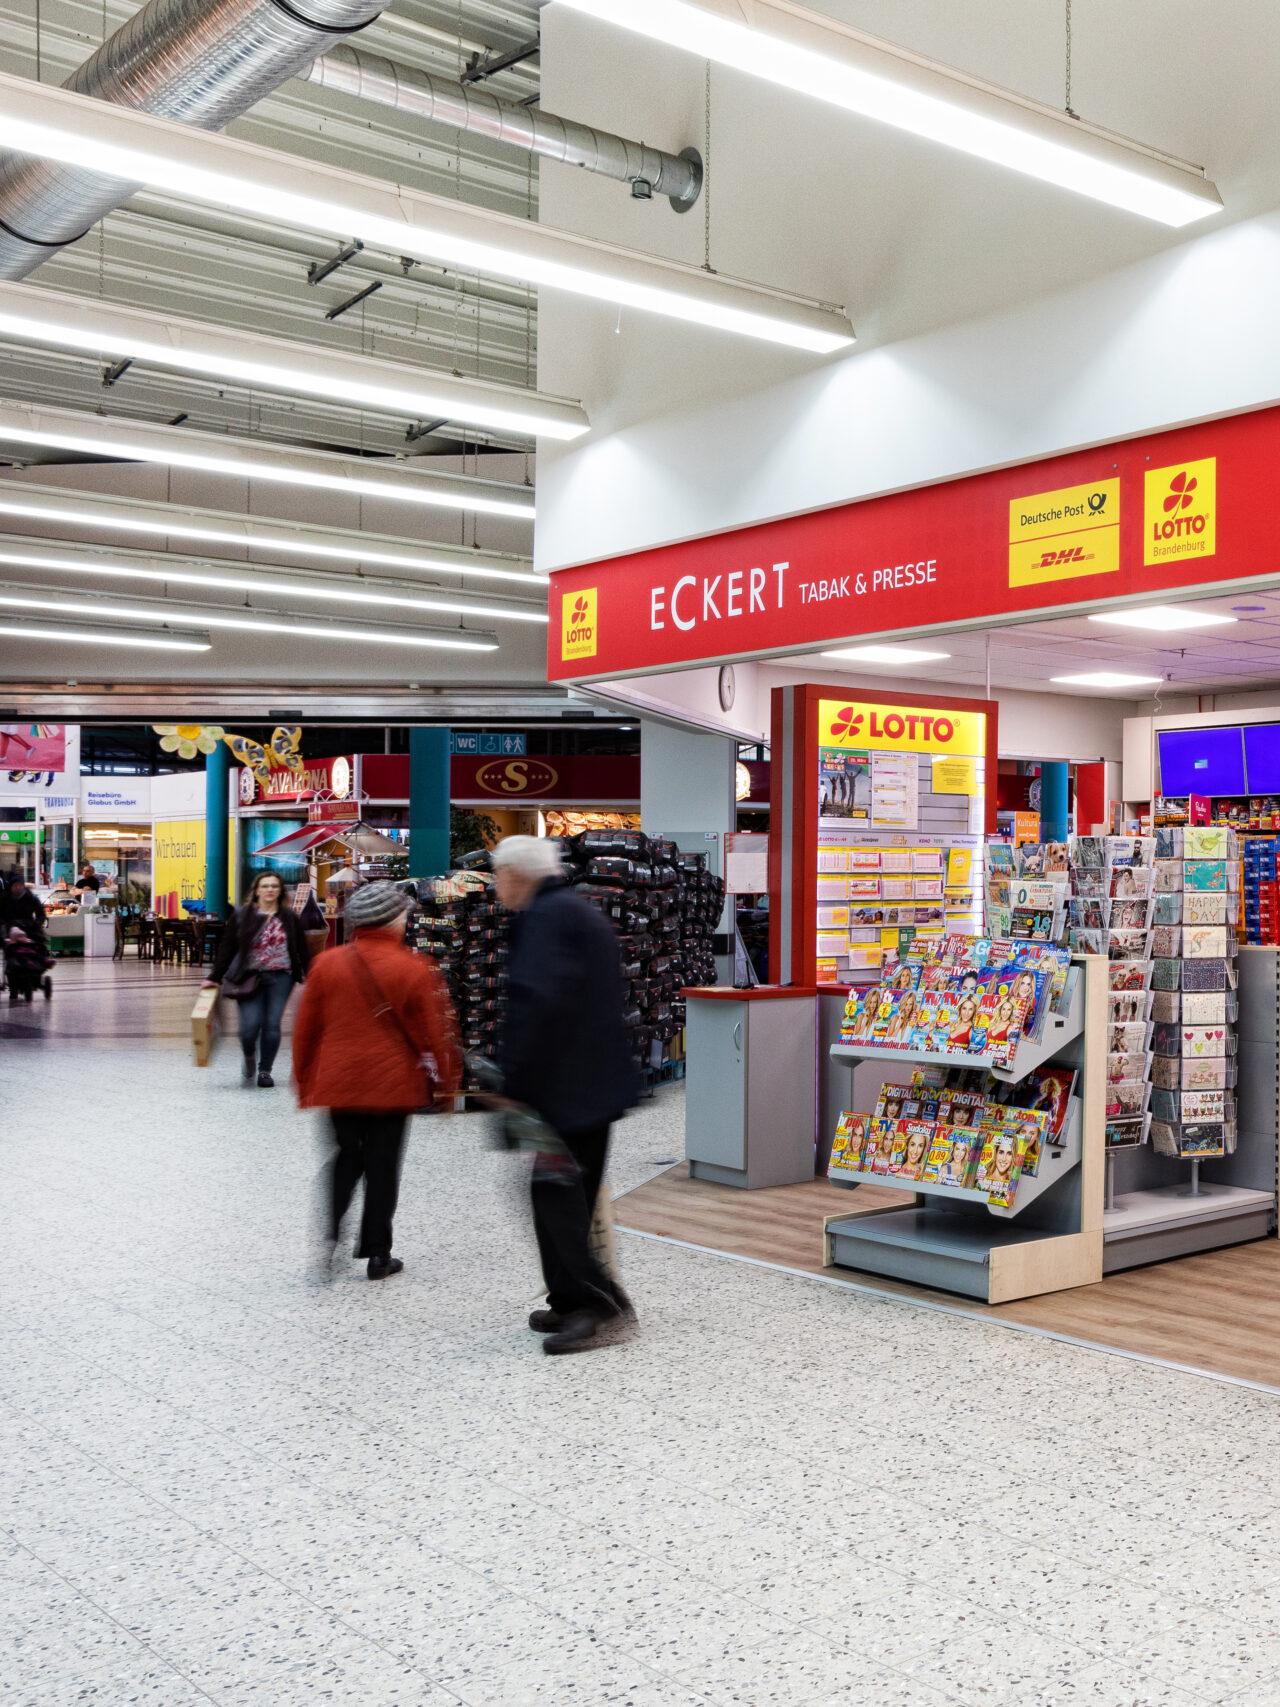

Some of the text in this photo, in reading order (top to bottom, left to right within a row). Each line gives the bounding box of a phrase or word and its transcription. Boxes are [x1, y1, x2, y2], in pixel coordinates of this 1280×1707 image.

[1020, 503, 1085, 527] Deutsche Post
[1153, 515, 1206, 541] LOTTO
[1039, 546, 1087, 568] DHL
[1153, 540, 1206, 557] Brandenburg
[650, 559, 938, 631] ECKERT TABAK & PRESSE
[566, 626, 593, 644] LOTTO
[565, 644, 592, 656] Brandenburg
[869, 711, 954, 743] LOTTO
[457, 736, 477, 750] WC
[500, 761, 529, 792] S
[154, 838, 198, 859] Wir bauen
[1189, 896, 1223, 907] HAPPY
[1033, 915, 1051, 932] 18
[1191, 911, 1218, 921] DAY
[887, 1087, 912, 1099] DIGITAL
[952, 1093, 985, 1107] DIGITAL
